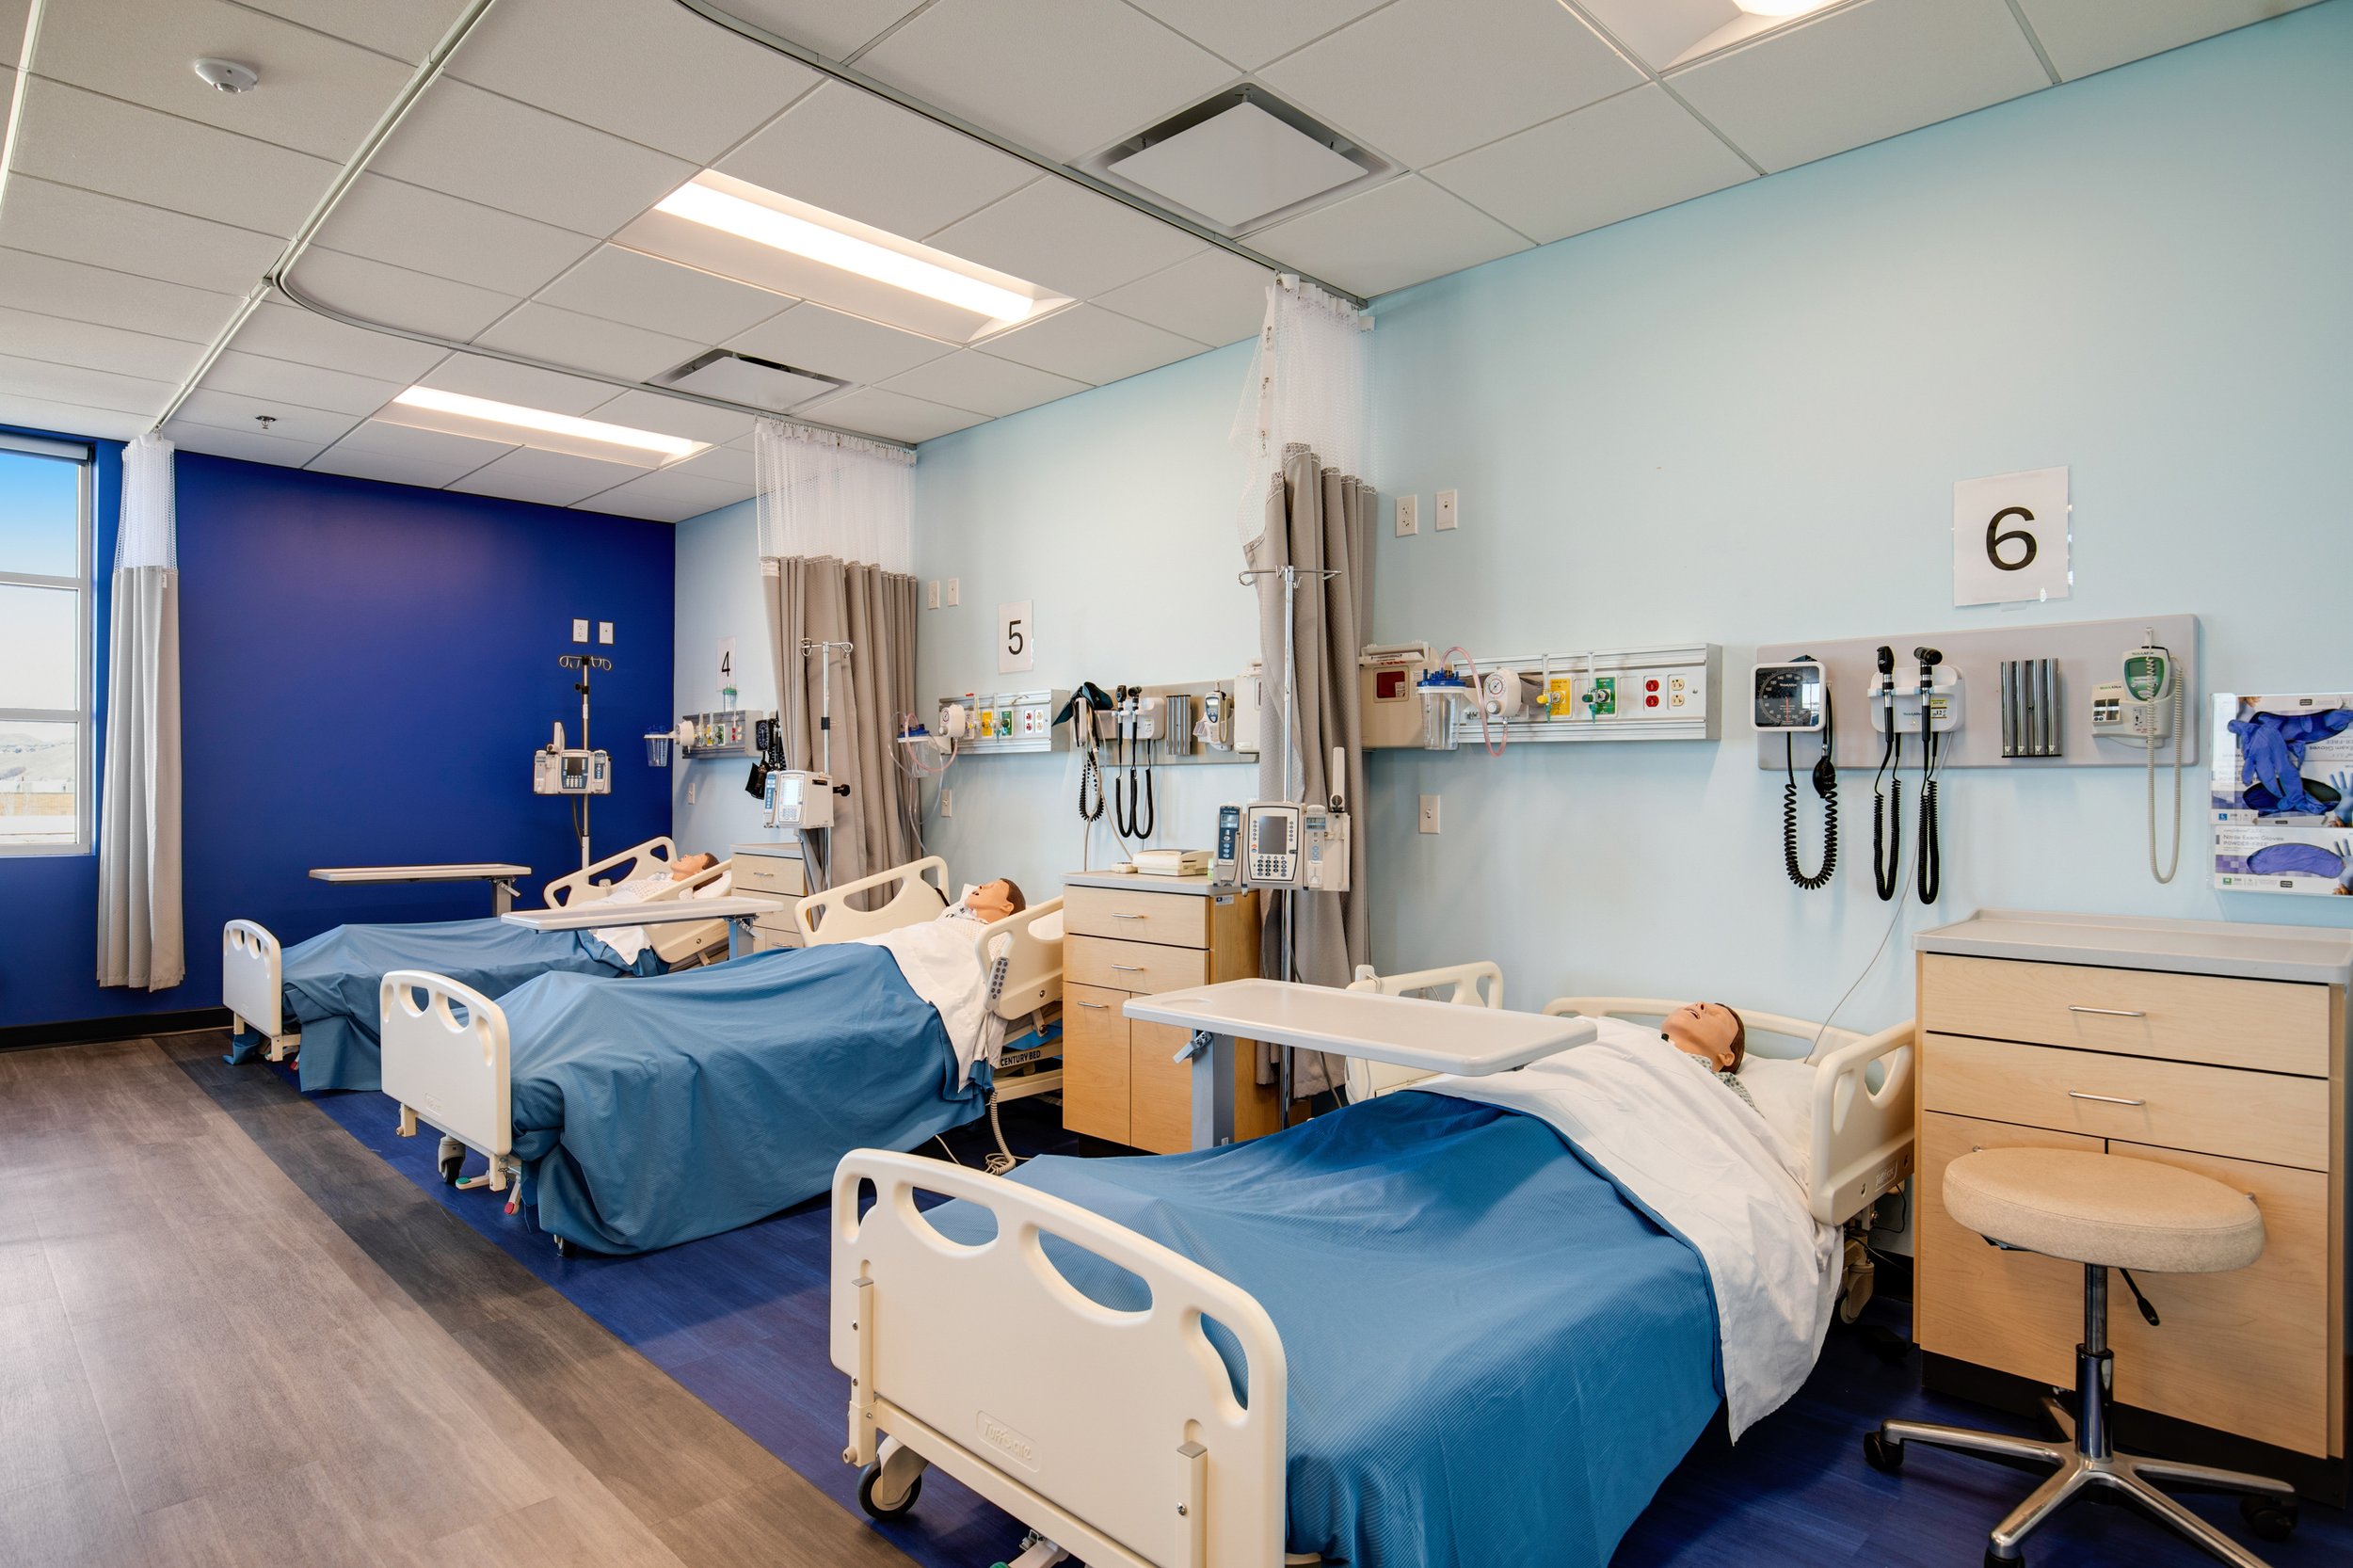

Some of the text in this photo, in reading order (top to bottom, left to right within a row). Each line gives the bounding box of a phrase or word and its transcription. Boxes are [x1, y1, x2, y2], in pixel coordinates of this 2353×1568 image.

[1986, 506, 2037, 571] 6
[1008, 619, 1023, 655] 5
[721, 650, 730, 678] 4
[1000, 1049, 1041, 1066] CENTURY BED
